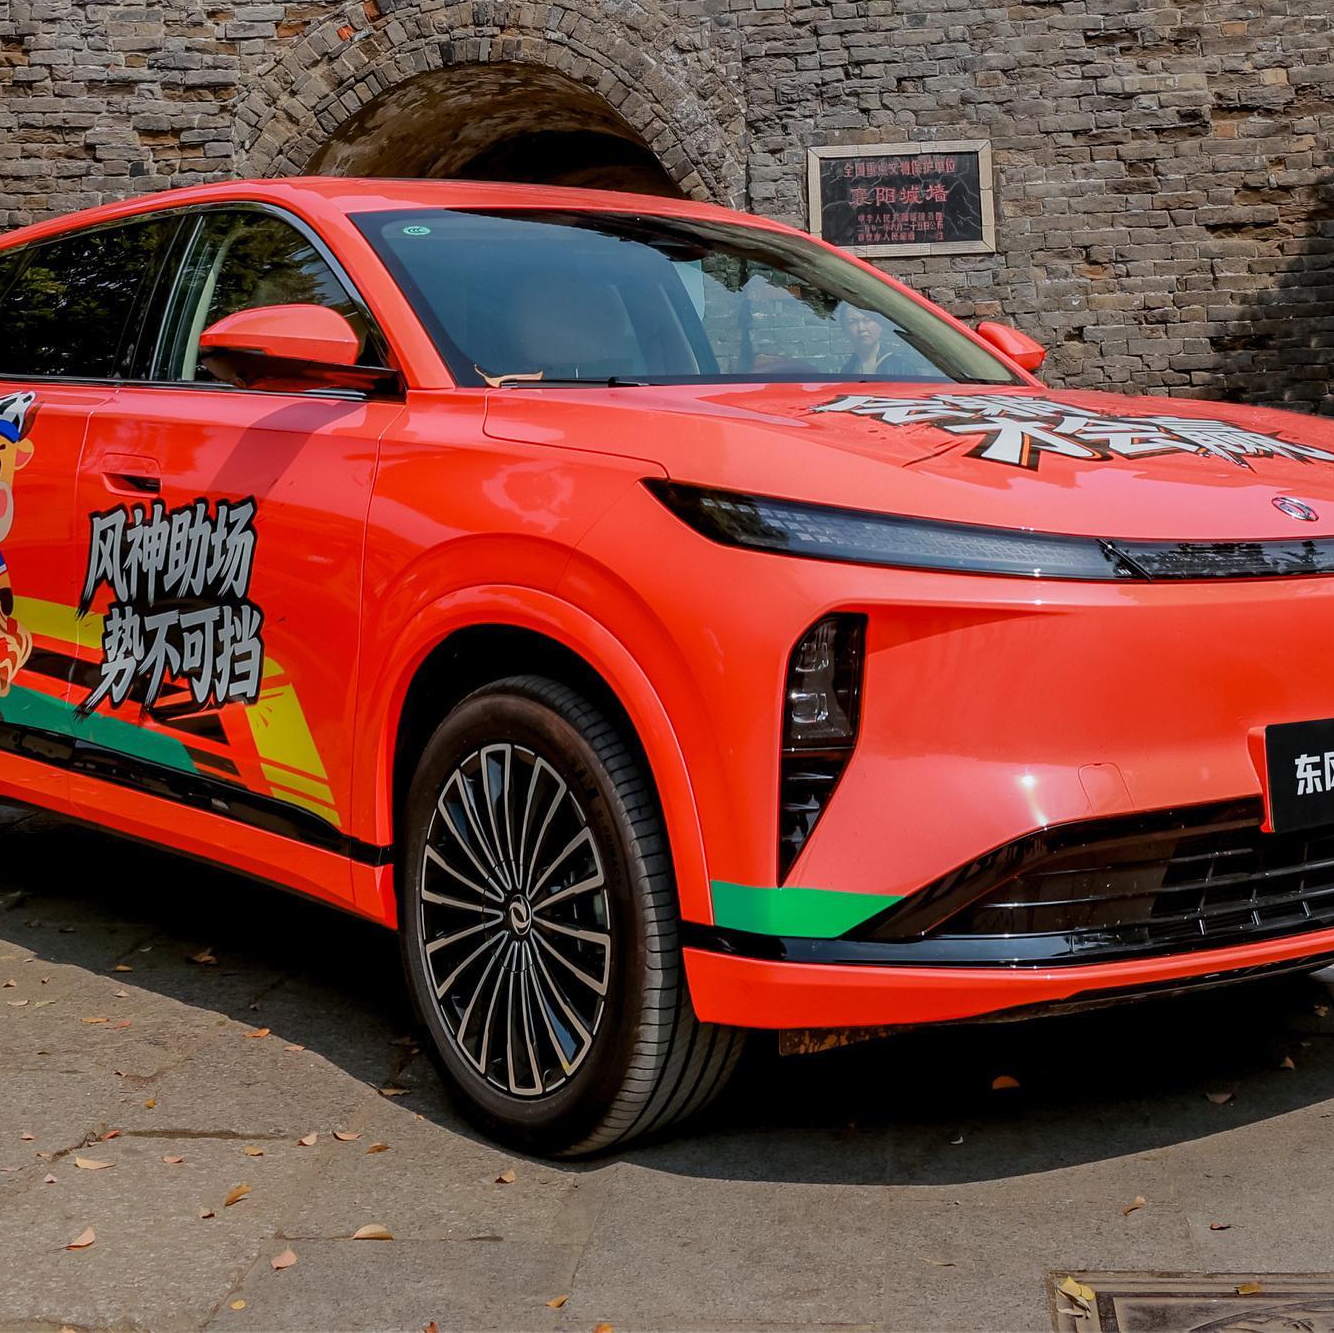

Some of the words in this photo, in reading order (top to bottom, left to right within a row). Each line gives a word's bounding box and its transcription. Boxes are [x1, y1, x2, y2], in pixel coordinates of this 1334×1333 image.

[844, 157, 956, 178] 全国重点文物保护单位
[849, 183, 949, 207] 襄阳城墙
[77, 500, 257, 618] 风神助场
[75, 604, 264, 721] 势不可挡
